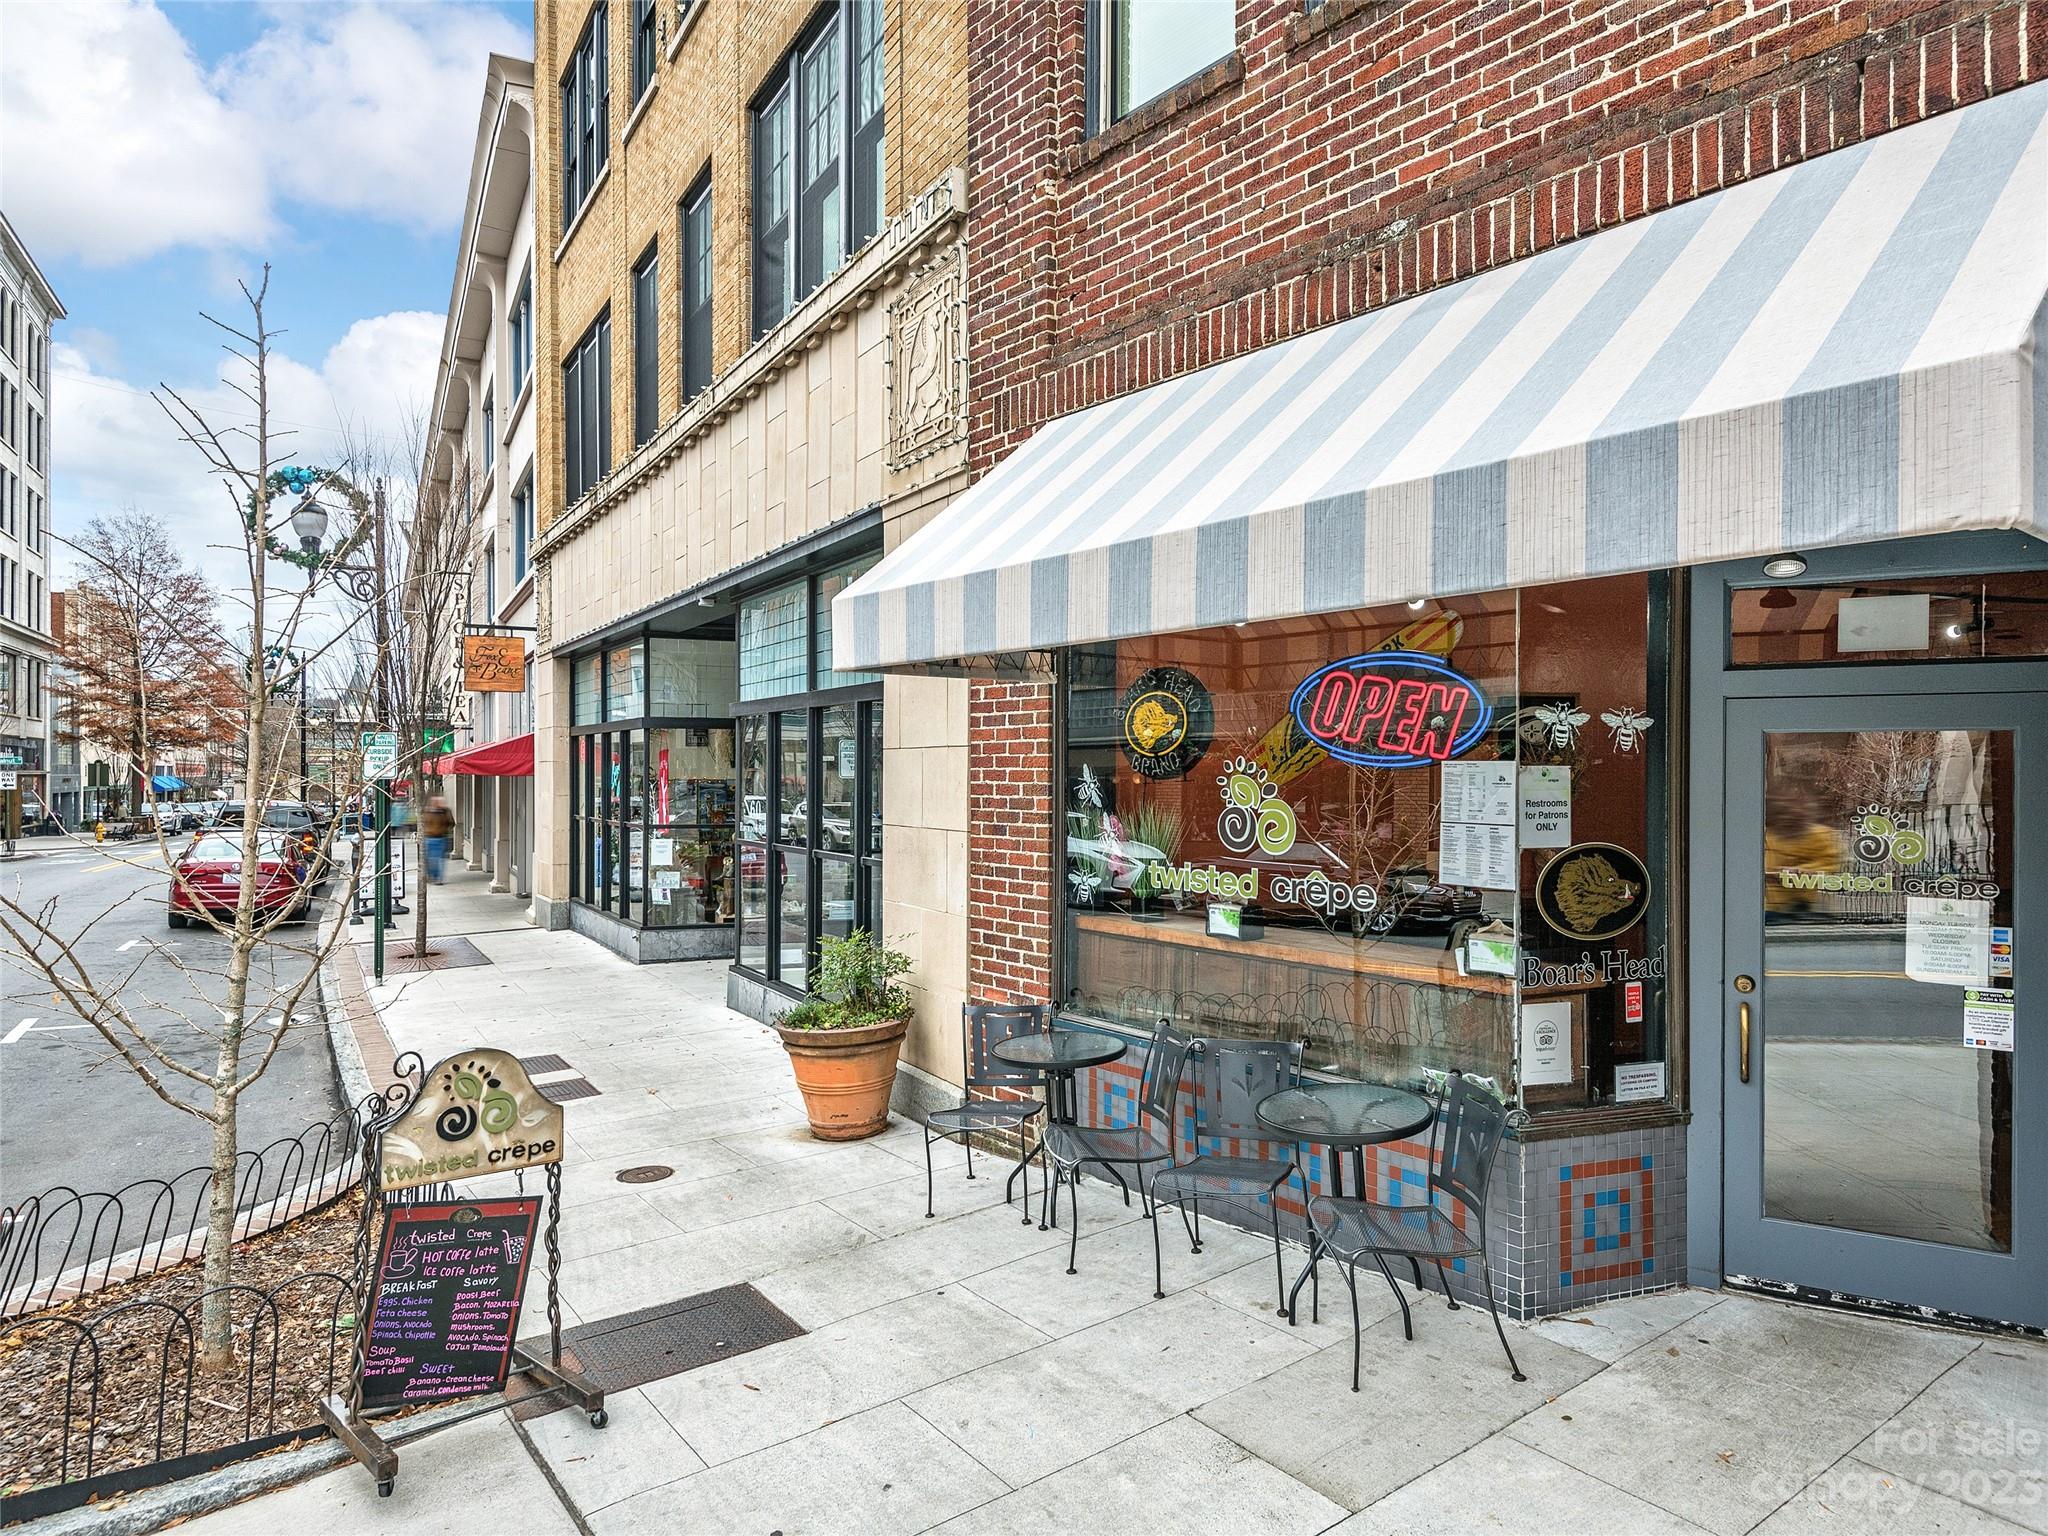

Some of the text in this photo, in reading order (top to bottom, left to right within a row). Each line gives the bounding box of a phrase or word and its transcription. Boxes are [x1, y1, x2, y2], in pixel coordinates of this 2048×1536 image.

[1310, 669, 1470, 760] OPEN
[1131, 751, 1181, 777] BRAND
[1525, 799, 1568, 808] Restrooms
[1525, 810, 1569, 819] for Patrons
[1536, 822, 1558, 831] ONLY
[1148, 859, 1378, 915] twisted crêpe
[1778, 869, 2000, 900] twisted crêpe
[1928, 932, 1966, 940] WEDNESDAY
[1520, 951, 1595, 988] Boar's
[1600, 944, 1666, 982] Head
[383, 1139, 556, 1184] twisted crêpe
[409, 1228, 492, 1246] twisted Crepe
[422, 1250, 444, 1263] HOT
